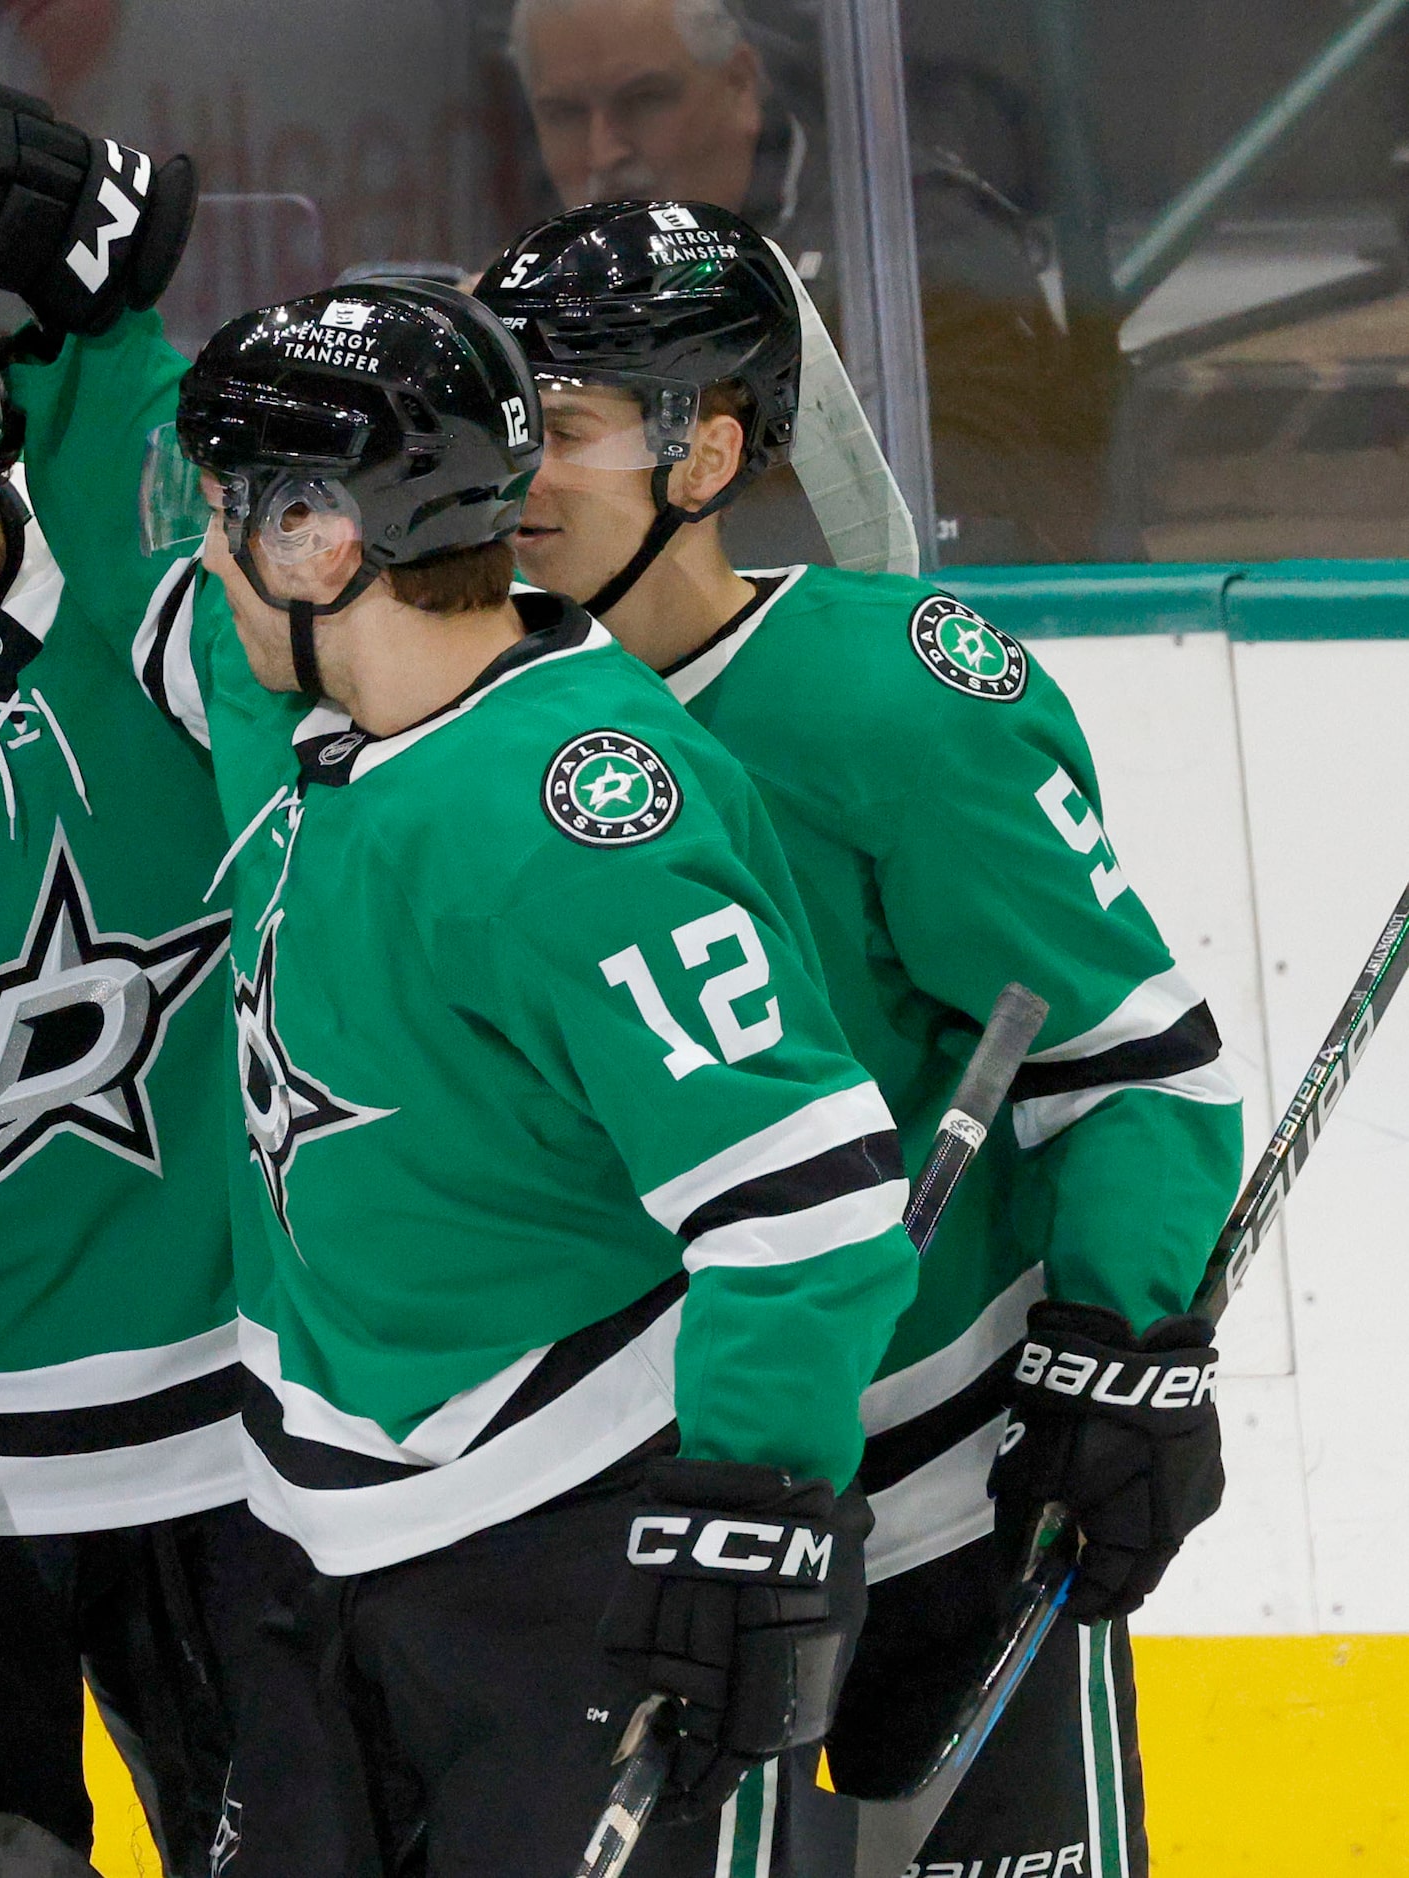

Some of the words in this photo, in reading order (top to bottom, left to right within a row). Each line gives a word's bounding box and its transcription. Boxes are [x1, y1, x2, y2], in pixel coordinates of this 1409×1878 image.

[647, 244, 740, 265] TRANSFER
[649, 230, 720, 251] ENERGY
[500, 253, 540, 289] 5
[284, 342, 380, 374] TRANSFER
[298, 325, 377, 352] ENERGY
[501, 396, 529, 447] 12
[968, 646, 1021, 693] STARS
[554, 739, 658, 797] DALLAS
[572, 796, 668, 836] STARS
[598, 903, 784, 1081] 12
[627, 1516, 833, 1582] CCM
